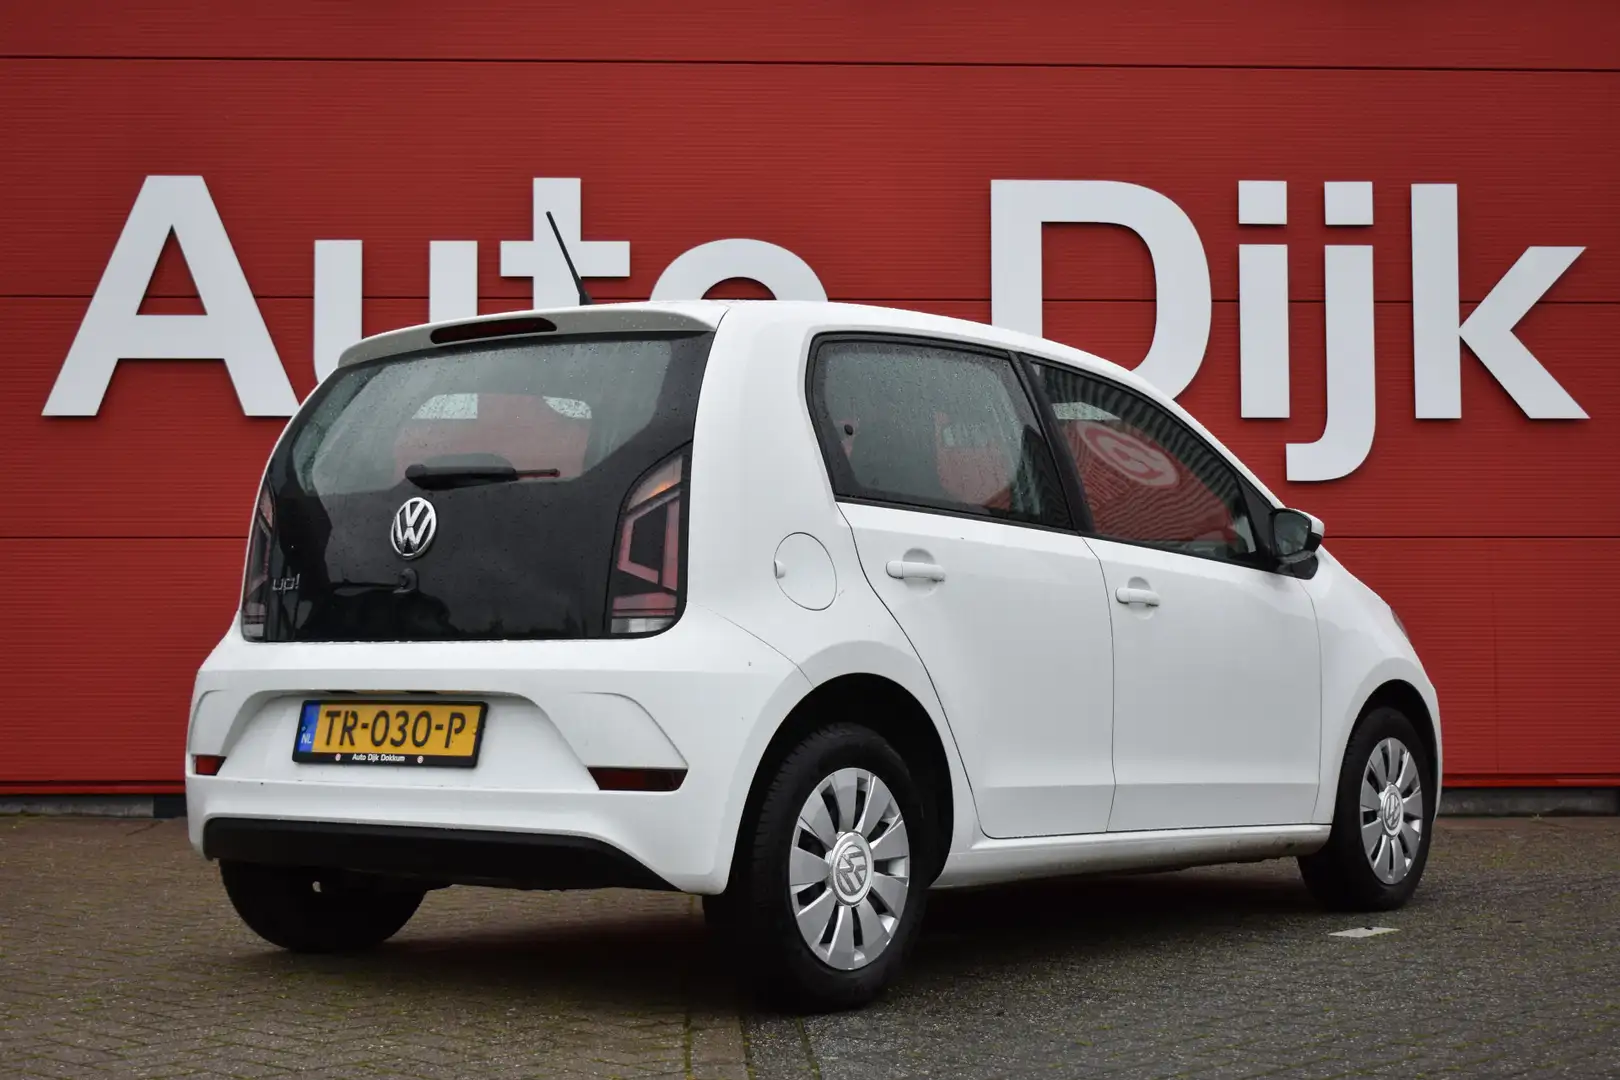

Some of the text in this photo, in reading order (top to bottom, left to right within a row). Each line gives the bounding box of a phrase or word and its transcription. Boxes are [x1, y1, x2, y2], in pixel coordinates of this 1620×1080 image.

[990, 179, 1589, 481] Dijk
[272, 573, 300, 595] up!
[301, 733, 312, 744] NL
[325, 710, 466, 748] TR-030-P
[367, 753, 379, 762] Dijk
